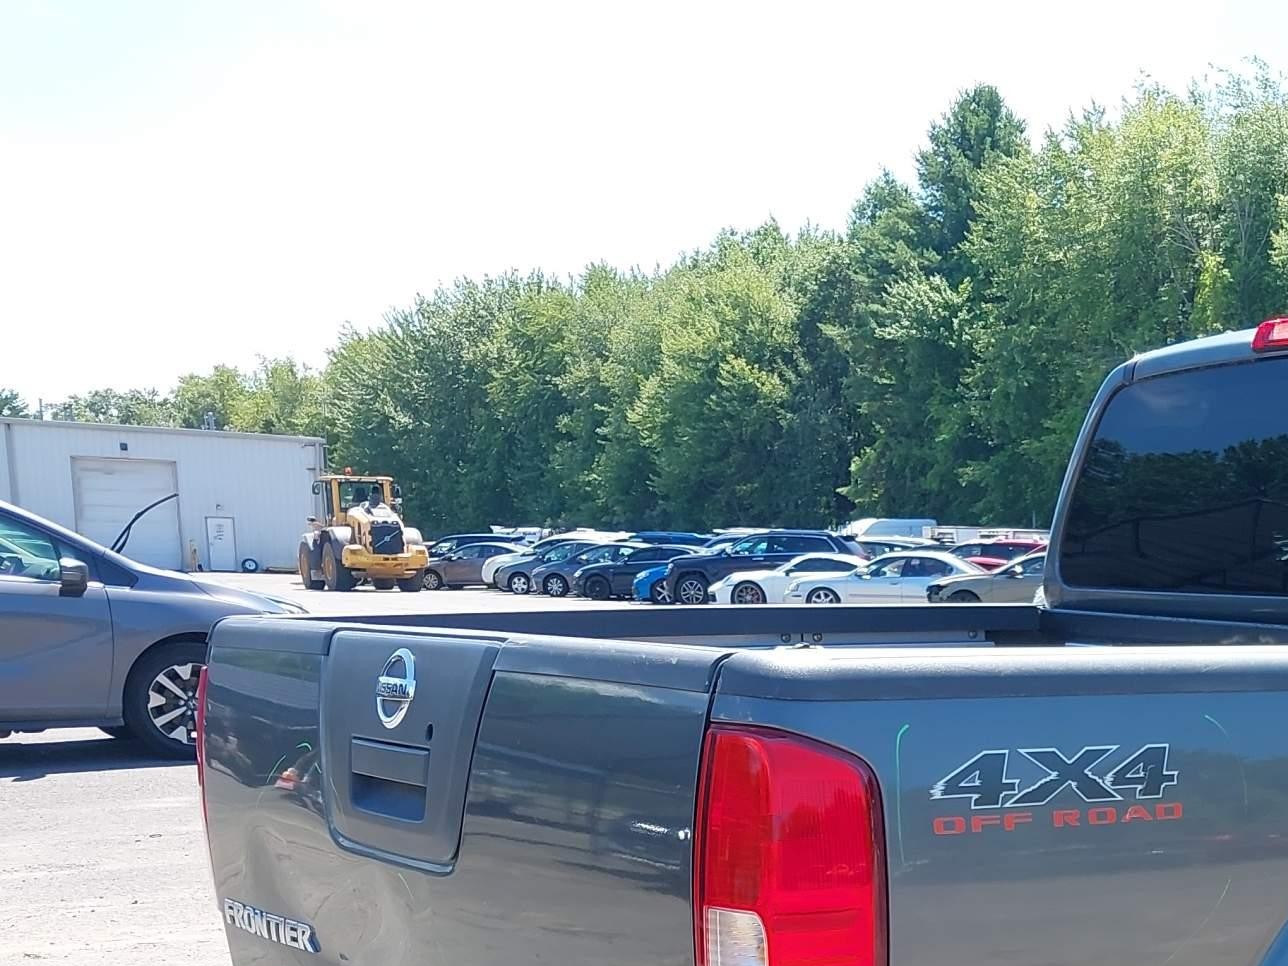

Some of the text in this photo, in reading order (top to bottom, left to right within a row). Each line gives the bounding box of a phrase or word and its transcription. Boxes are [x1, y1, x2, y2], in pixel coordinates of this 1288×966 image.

[929, 744, 1179, 809] 4X4
[933, 803, 1183, 835] OFF ROAD
[224, 897, 321, 954] FRONTIER
